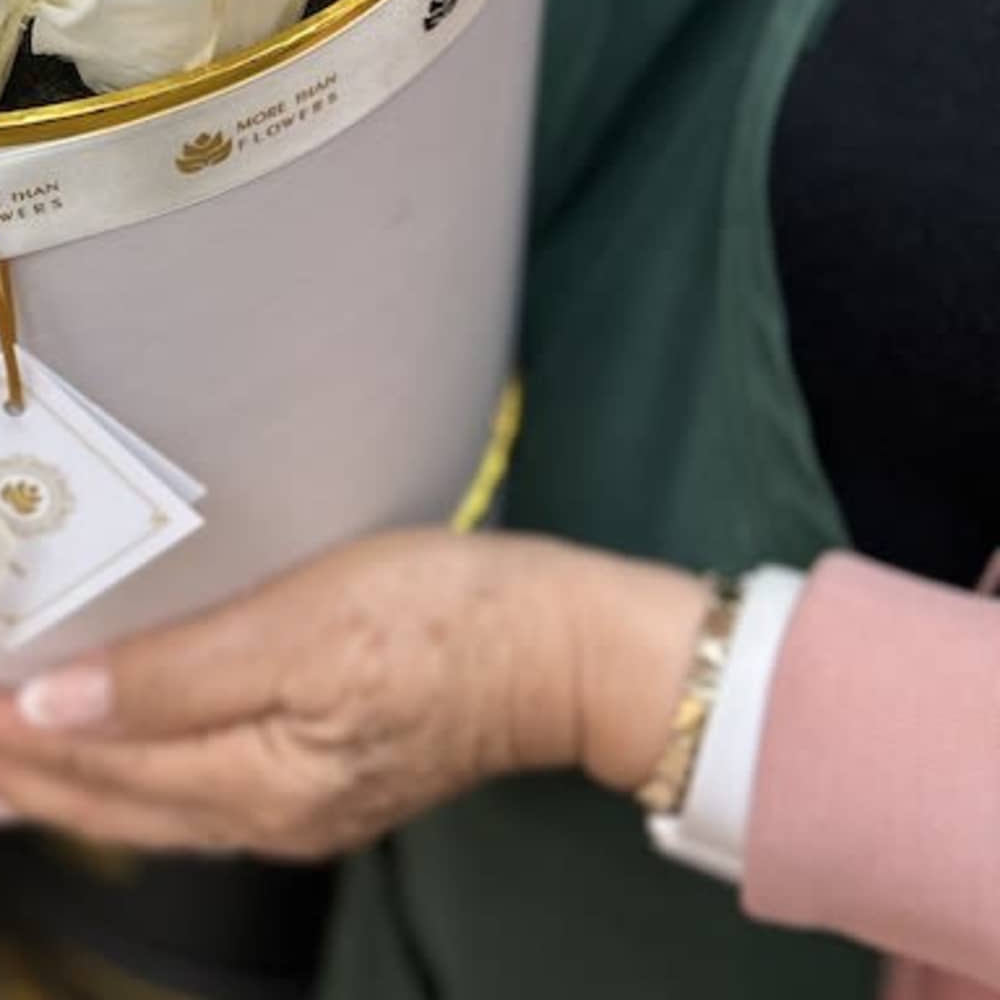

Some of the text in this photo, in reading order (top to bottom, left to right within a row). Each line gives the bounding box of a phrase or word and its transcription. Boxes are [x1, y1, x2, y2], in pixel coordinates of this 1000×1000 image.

[237, 72, 336, 133] MORE THAN
[239, 93, 337, 151] FLOWERS
[11, 181, 59, 203] THAN
